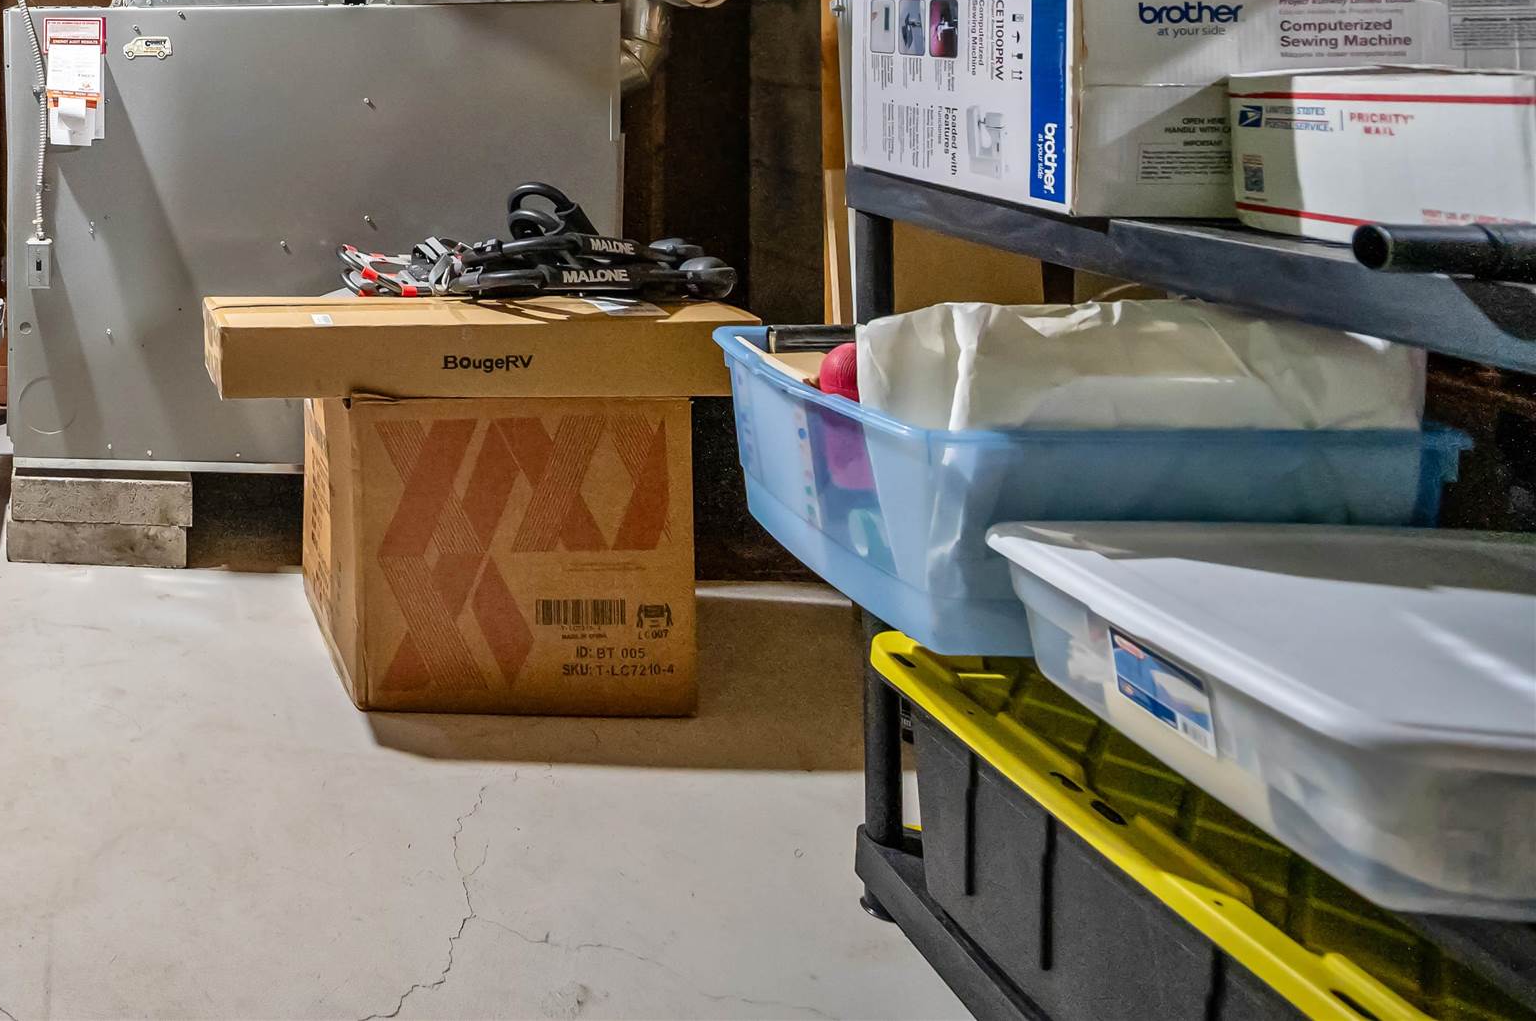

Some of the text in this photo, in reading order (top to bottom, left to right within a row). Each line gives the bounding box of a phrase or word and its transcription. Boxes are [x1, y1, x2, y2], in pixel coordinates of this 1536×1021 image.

[1138, 2, 1242, 25] brother
[976, 0, 986, 66] Computerized
[1157, 26, 1226, 38] at your side
[1279, 19, 1393, 34] Computerized
[995, 0, 1005, 82] CE1100PRW
[1280, 33, 1413, 50] Sewing Machine
[1265, 106, 1326, 116] UNITED STATES
[1349, 112, 1412, 124] PRIORITY
[951, 107, 959, 149] Loaded
[1182, 117, 1205, 125] OPEN
[944, 106, 952, 155] Features
[1164, 126, 1196, 134] HANDLE
[1199, 126, 1221, 134] WITH
[1363, 126, 1395, 136] MAIL
[1183, 139, 1223, 147] IMPORTANT
[1044, 122, 1058, 195] brother
[590, 238, 636, 256] MALONE
[562, 269, 631, 283] MALONE
[442, 355, 533, 373] BougeRV
[576, 646, 646, 659] ID: BT 005
[562, 664, 593, 676] SKU:
